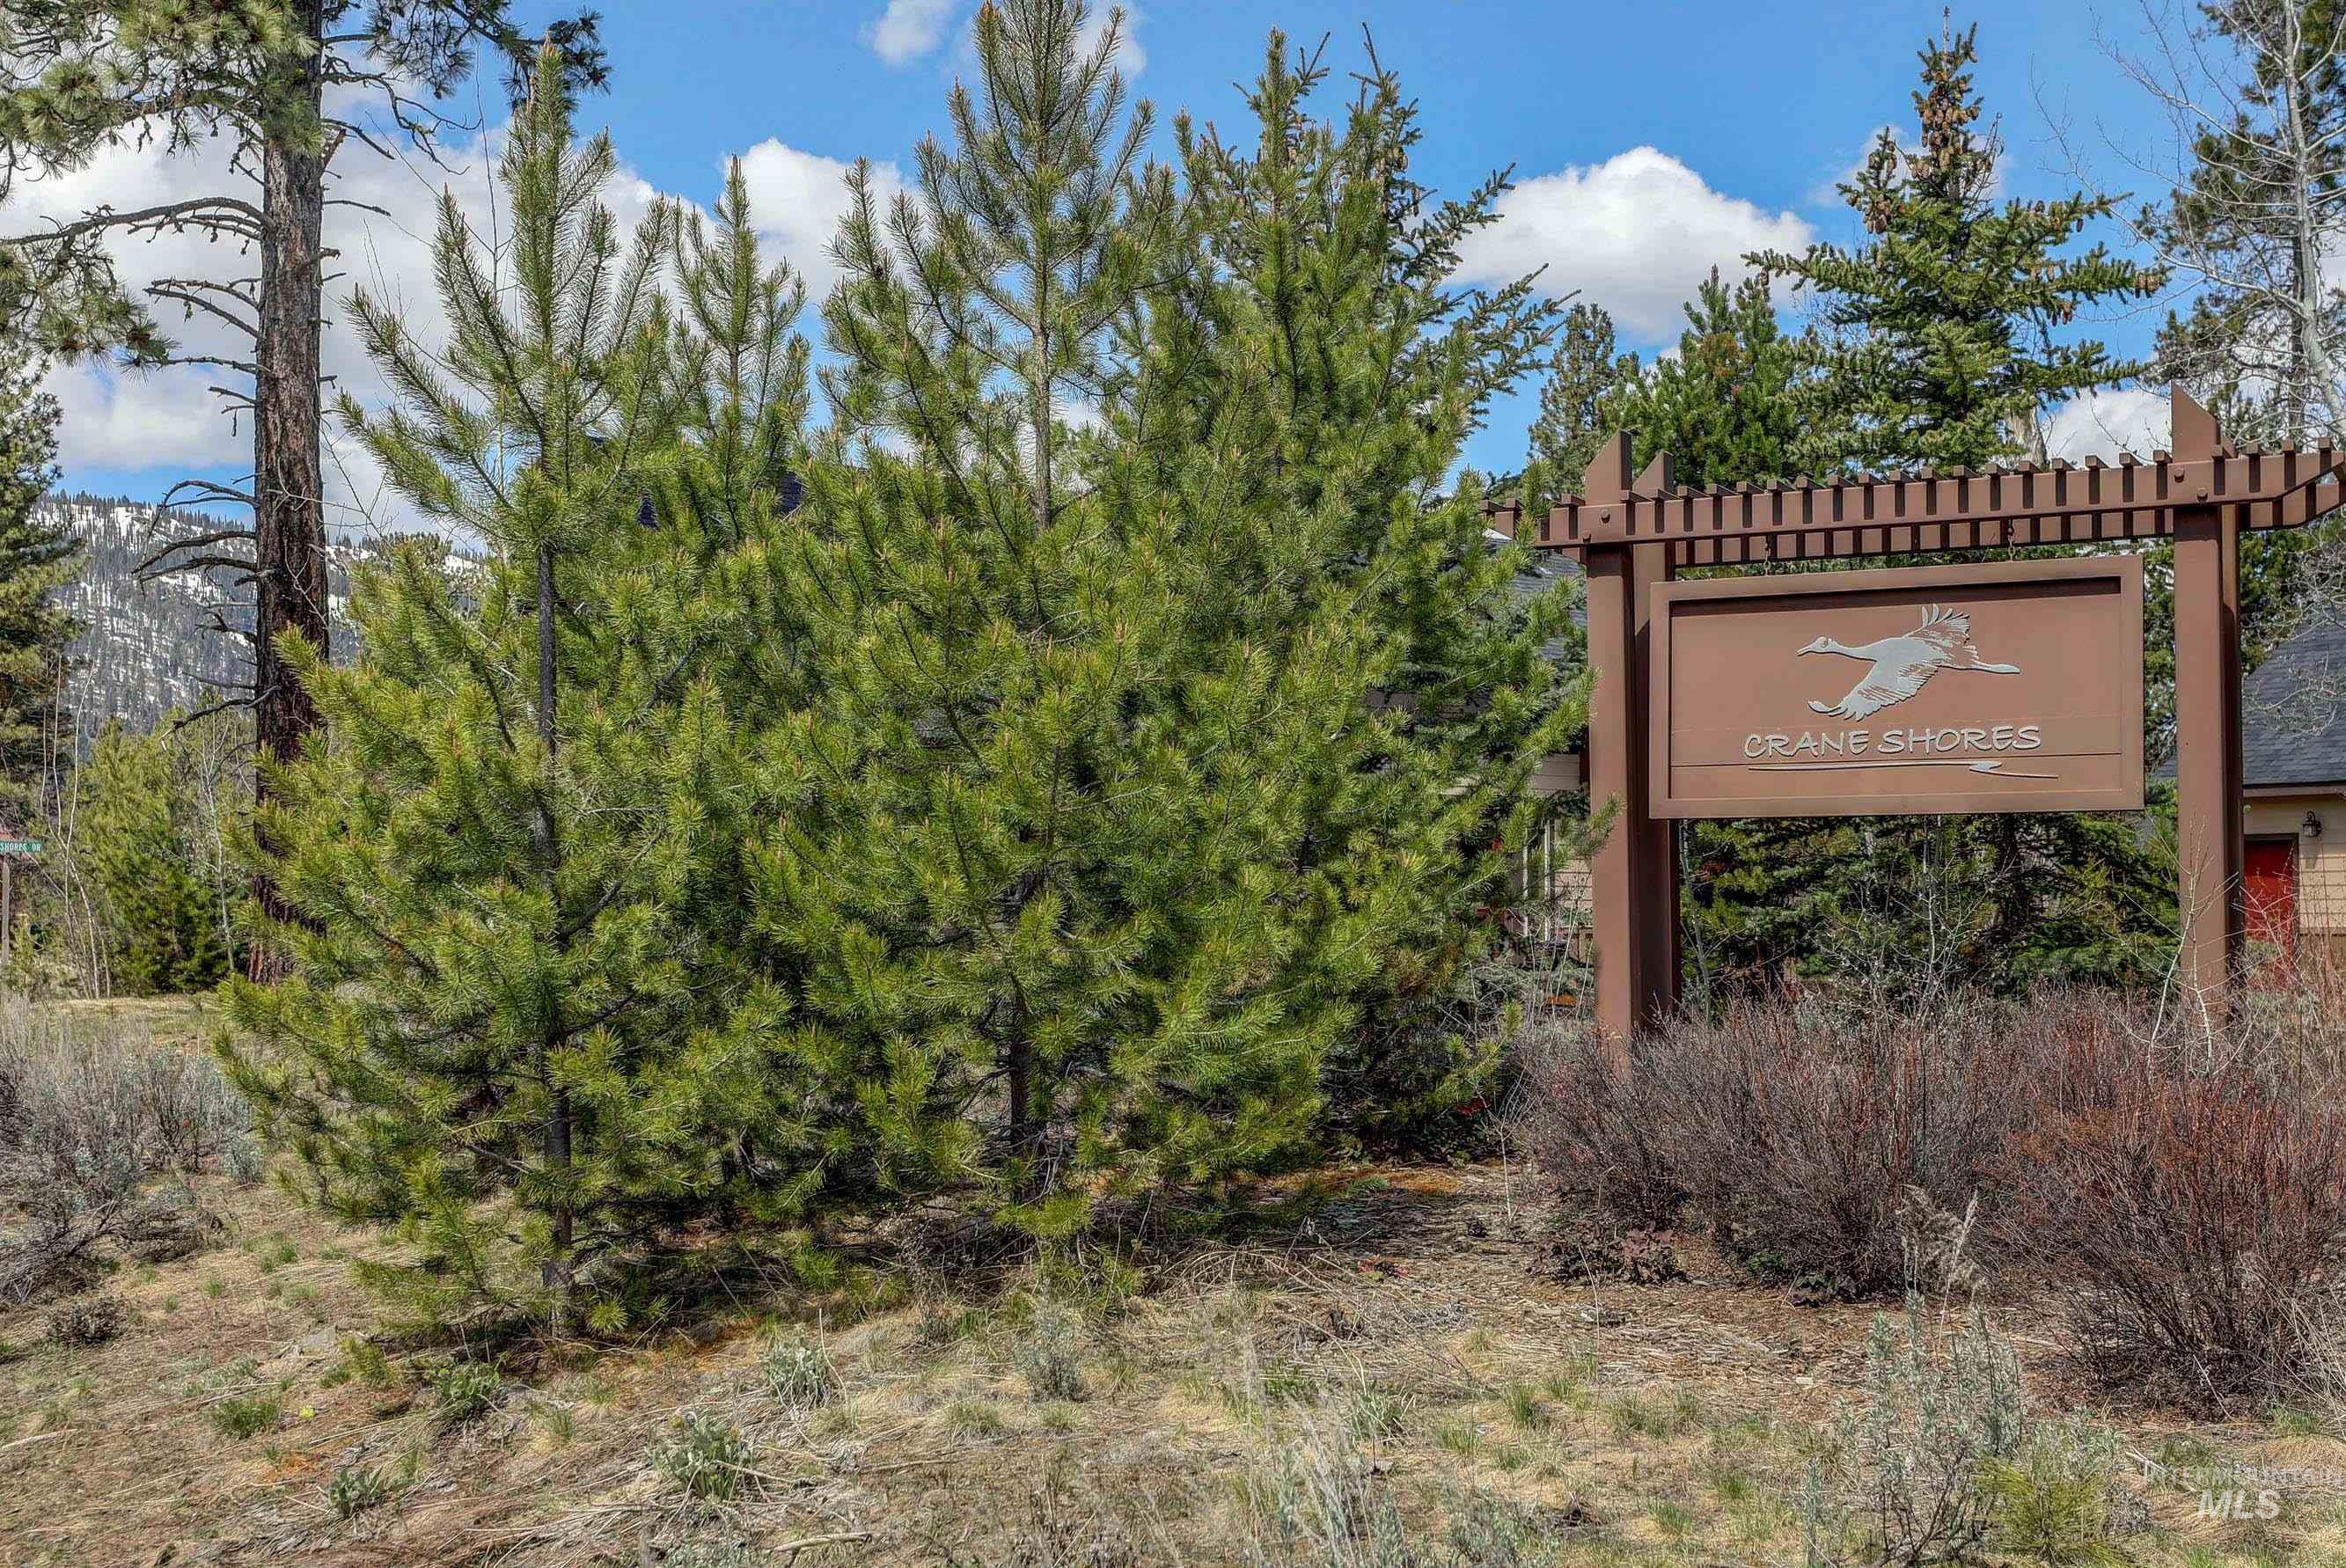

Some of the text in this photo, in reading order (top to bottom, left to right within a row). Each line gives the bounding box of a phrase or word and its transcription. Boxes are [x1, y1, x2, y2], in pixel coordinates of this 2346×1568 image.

[1744, 725, 2042, 758] CRANE SHORES
[0, 842, 42, 853] SHORES DR
